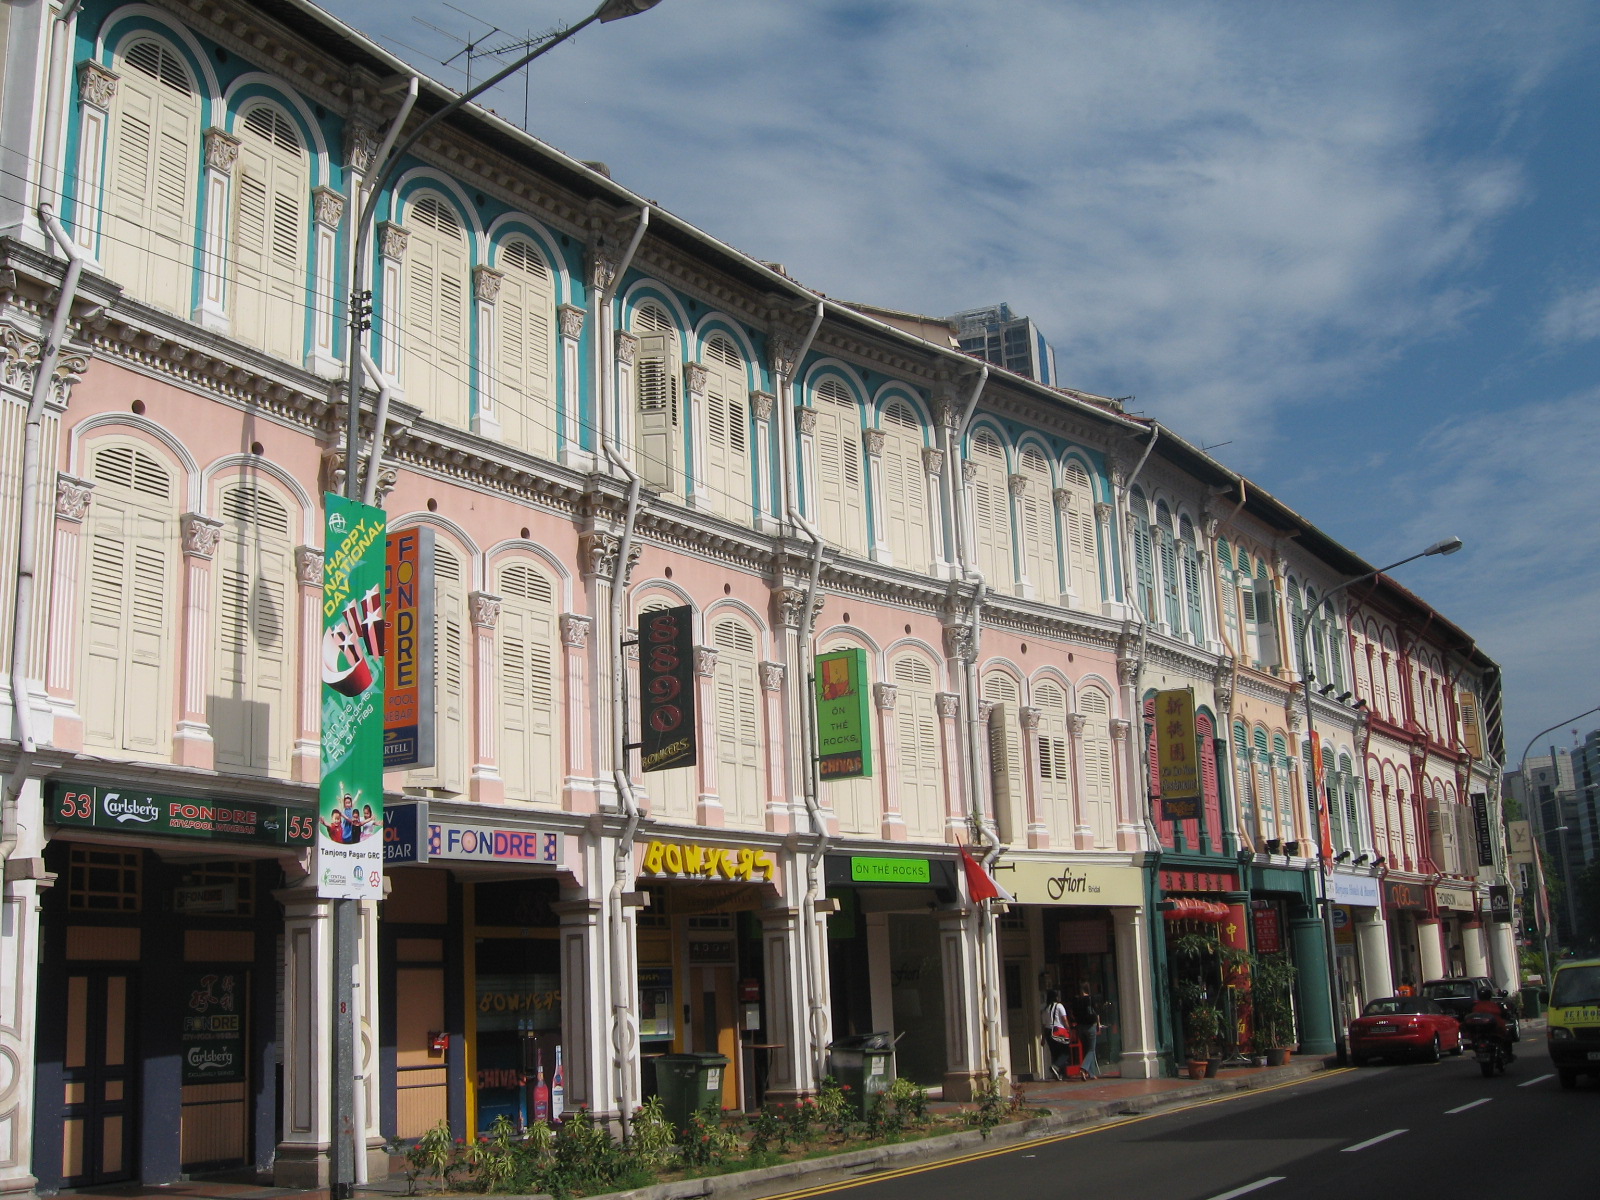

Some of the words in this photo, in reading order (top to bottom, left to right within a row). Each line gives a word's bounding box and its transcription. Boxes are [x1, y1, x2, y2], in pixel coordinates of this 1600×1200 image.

[324, 520, 385, 597] NATIONAL
[325, 518, 366, 575] HAPPY
[323, 580, 350, 617] DAY
[397, 536, 415, 687] FONDRE
[820, 758, 862, 774] CHIVAS
[61, 792, 92, 818] 53
[103, 793, 159, 822] Carlsberg
[169, 803, 257, 824] FONDRE
[288, 816, 313, 839] 55
[321, 848, 347, 858] Tanjong
[349, 850, 366, 859] Pagar
[340, 1001, 346, 1014] 8
[188, 1047, 233, 1071] Carlsberg
